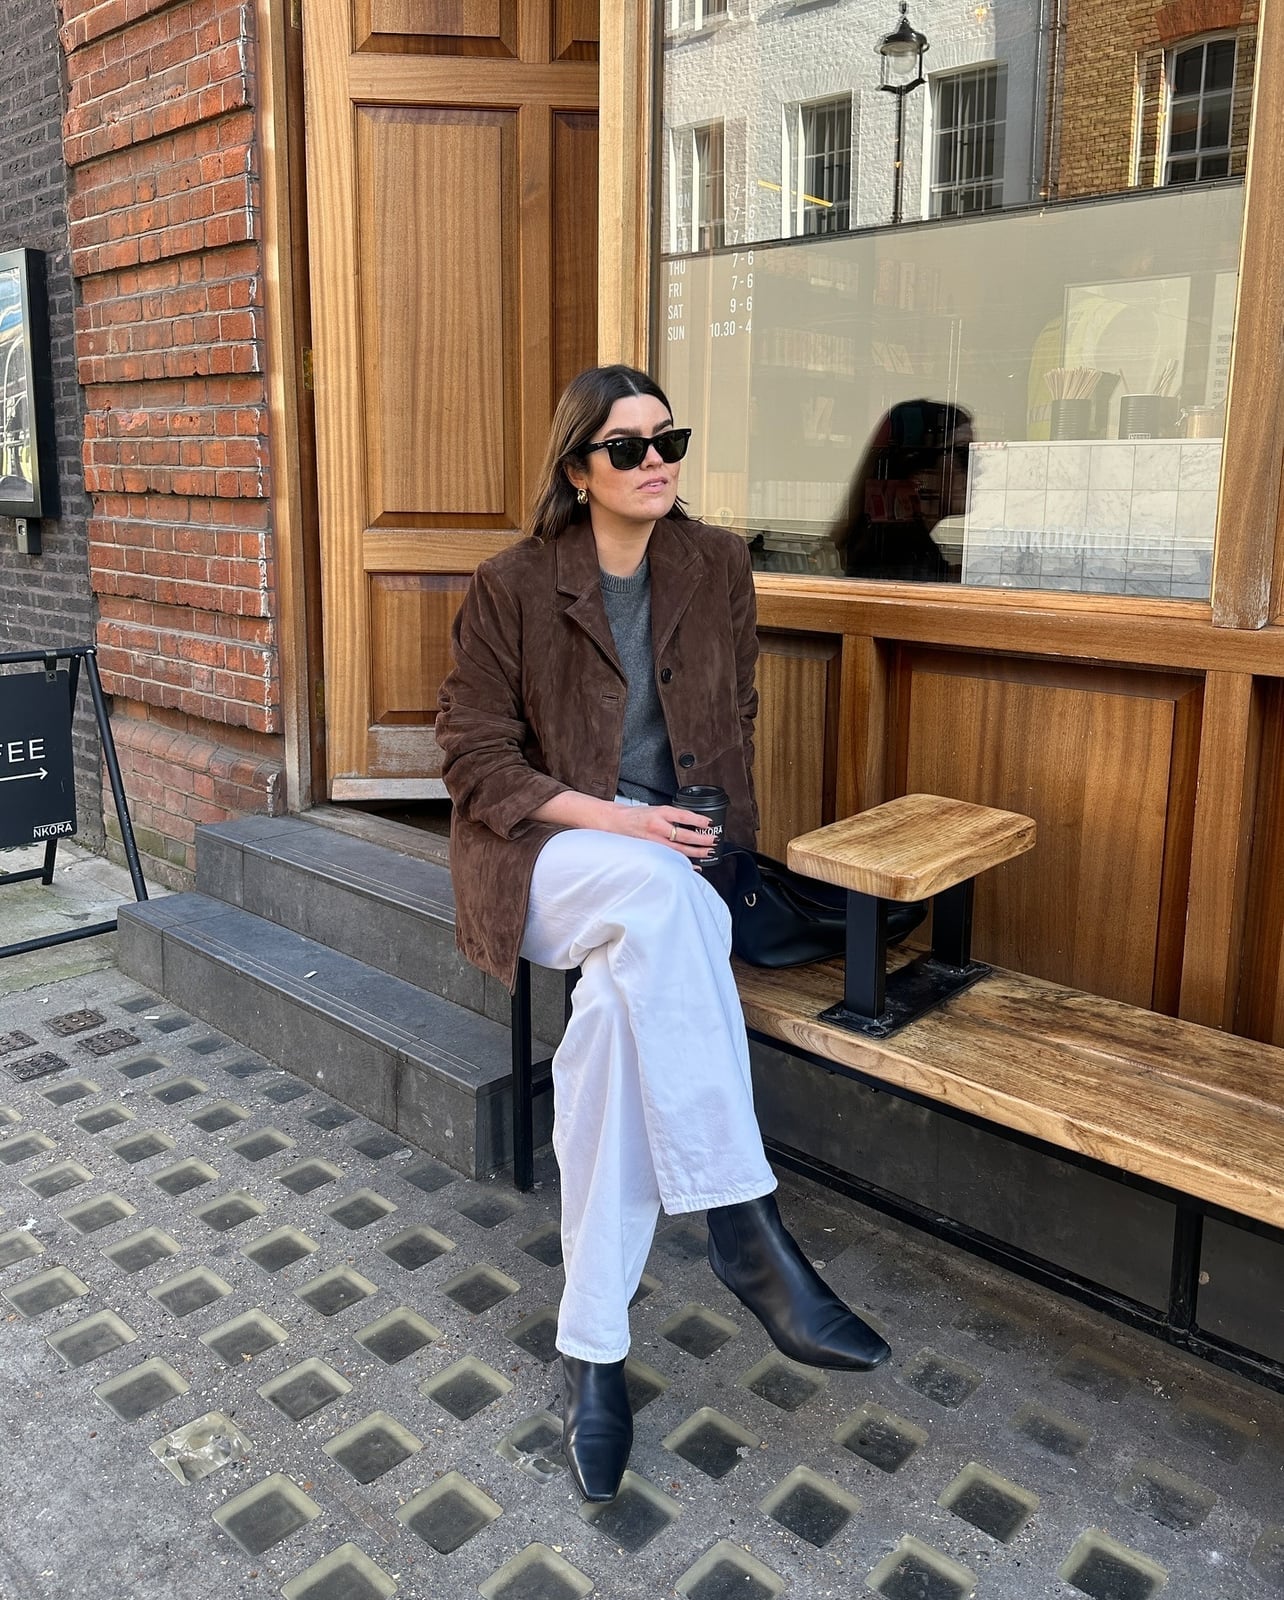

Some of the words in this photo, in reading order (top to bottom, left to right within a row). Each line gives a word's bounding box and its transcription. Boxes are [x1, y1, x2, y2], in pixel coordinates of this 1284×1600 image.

[669, 260, 686, 277] THU
[668, 282, 683, 298] FRI
[667, 303, 684, 320] SAT
[667, 326, 685, 341] SUN
[0, 738, 45, 762] EE
[33, 822, 73, 838] NKORA
